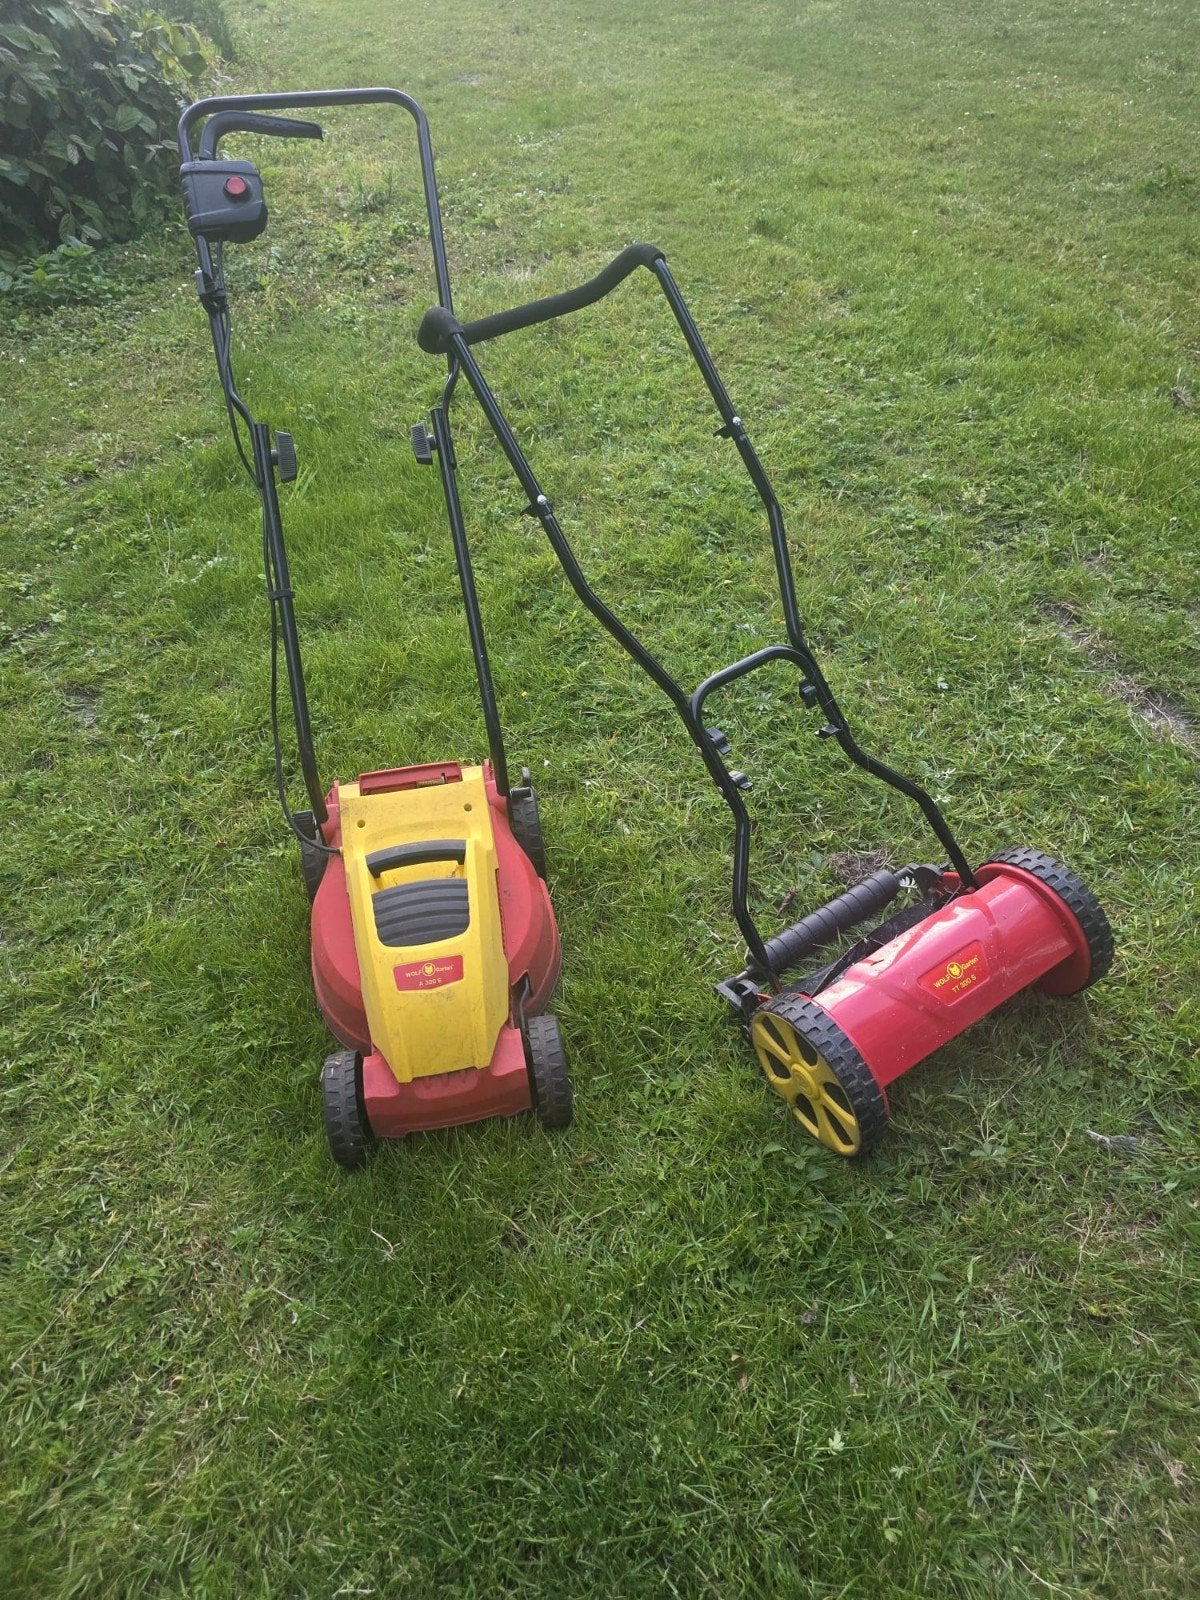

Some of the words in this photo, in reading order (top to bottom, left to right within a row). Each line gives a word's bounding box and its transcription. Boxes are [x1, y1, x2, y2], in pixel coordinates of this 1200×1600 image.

[405, 970, 423, 978] WOLF
[933, 974, 950, 988] WOLF
[952, 984, 960, 993] TT
